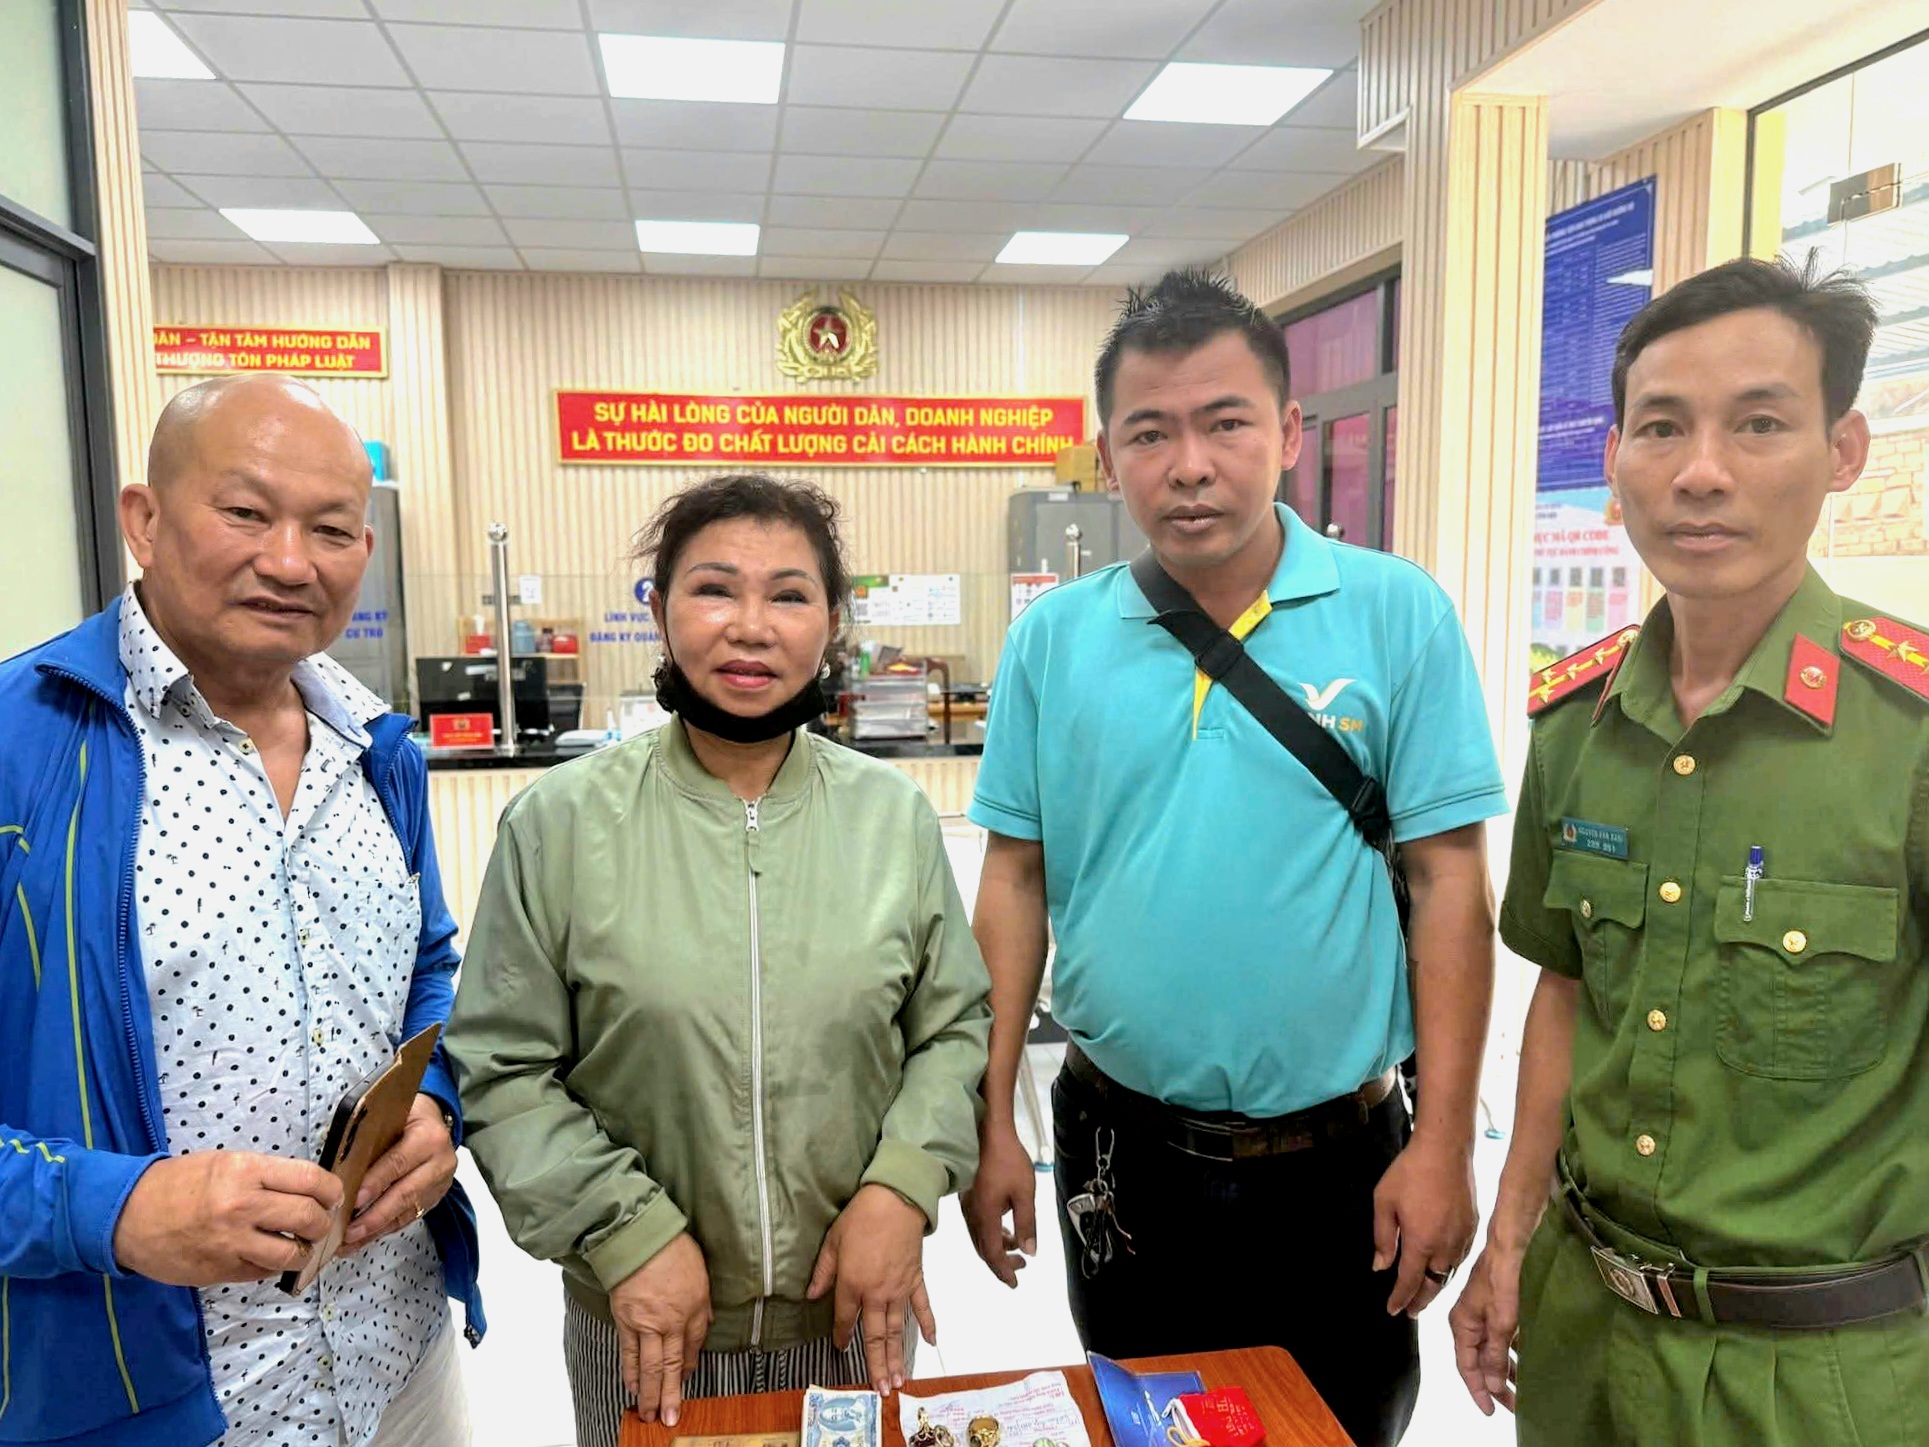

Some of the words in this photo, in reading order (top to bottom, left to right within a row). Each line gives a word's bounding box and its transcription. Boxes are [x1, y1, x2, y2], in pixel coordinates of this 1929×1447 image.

[200, 332, 231, 349] TẬN
[229, 351, 261, 368] TÔN
[266, 352, 311, 368] PHÁP
[315, 352, 355, 371] LUẬT
[594, 401, 626, 426] SỰ
[631, 399, 668, 423] HÀI
[673, 401, 731, 424] LÒNG
[736, 401, 779, 425] CỦA
[784, 402, 848, 425] NGƯỜI
[854, 404, 900, 428] DÂN,
[906, 407, 974, 426] DOANH
[980, 404, 1053, 429] NGHIỆP
[572, 428, 600, 451] LÀ
[603, 430, 678, 452] THƯỚC
[682, 433, 713, 452] ĐO
[719, 429, 773, 453] CHẤT
[778, 433, 848, 457] LƯỢNG
[853, 432, 886, 454] CẢI
[892, 432, 946, 454] CÁCH
[952, 432, 1007, 454] HÀNH
